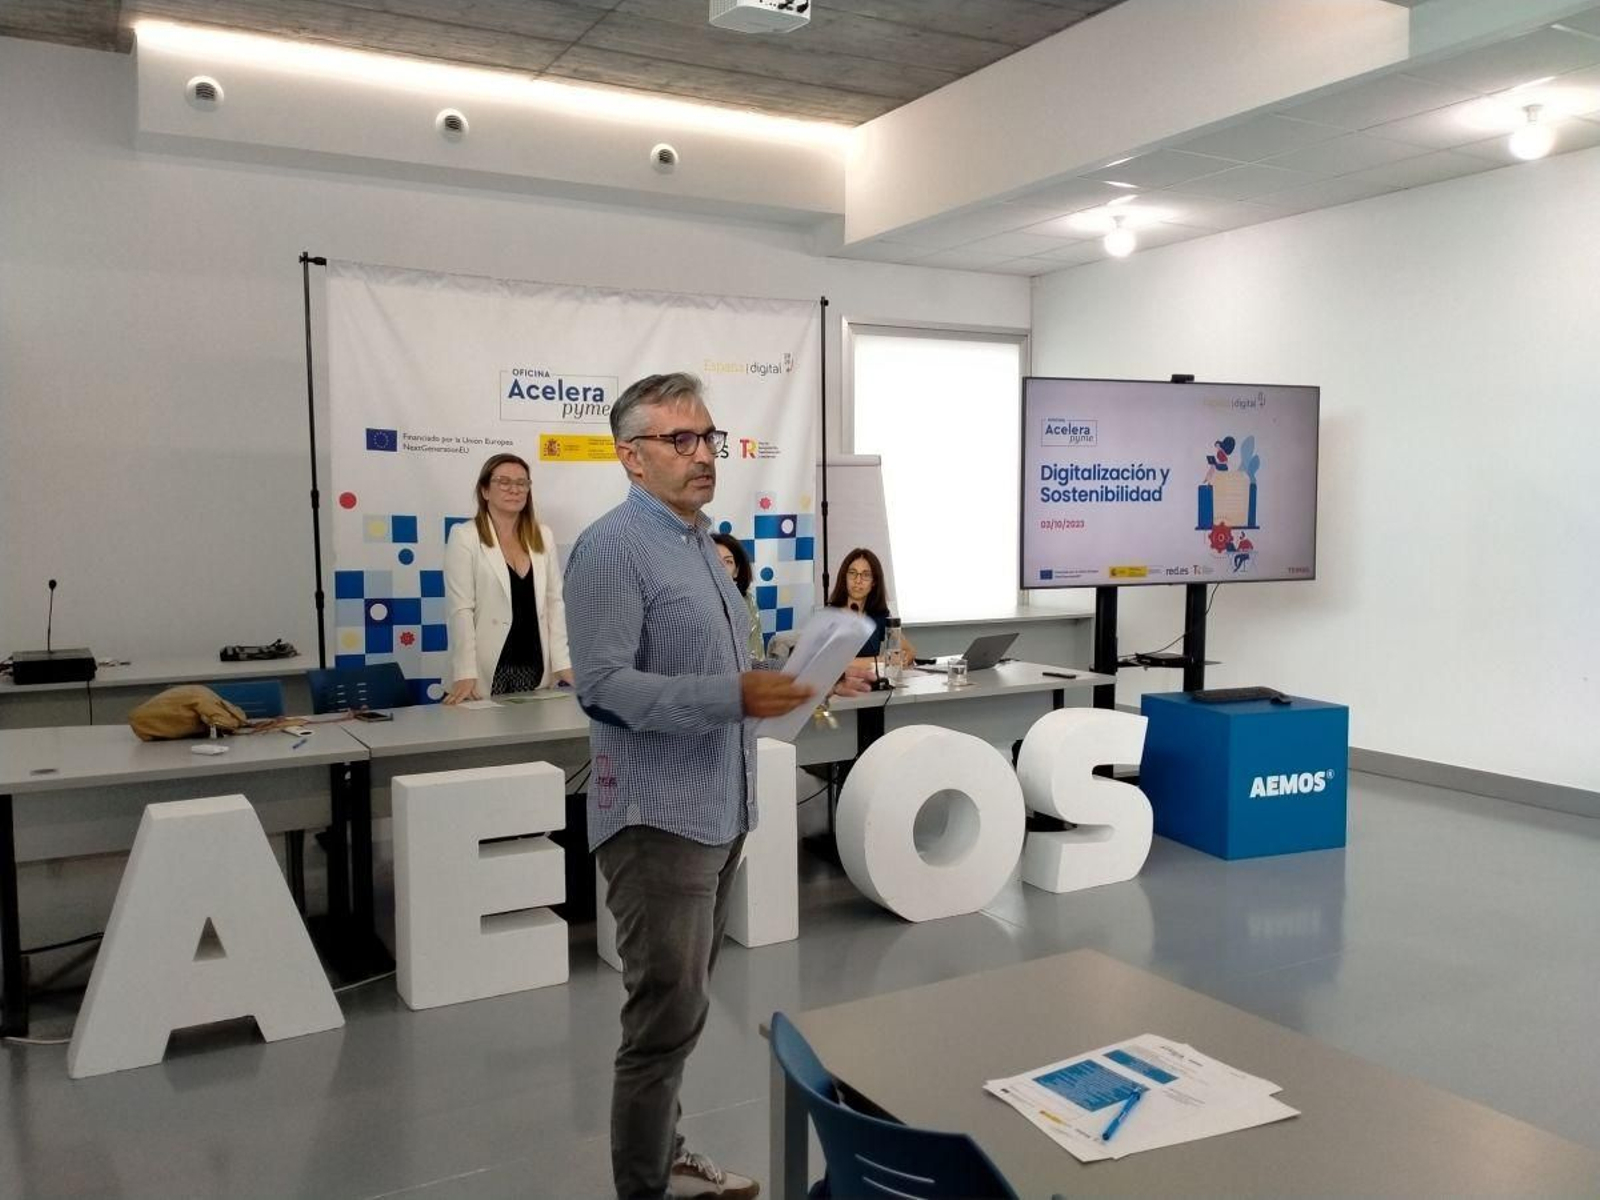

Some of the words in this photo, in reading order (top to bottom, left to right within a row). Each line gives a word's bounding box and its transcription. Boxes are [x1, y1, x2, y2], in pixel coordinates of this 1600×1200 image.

[512, 368, 551, 378] OFICINA
[749, 362, 782, 376] digital
[508, 379, 605, 402] Acelera
[562, 402, 611, 419] pyme
[1045, 422, 1091, 435] Acelera
[403, 432, 441, 442] Financiado
[441, 437, 453, 445] por
[455, 436, 462, 444] la
[1040, 463, 1157, 486] Digitalización
[1160, 468, 1170, 486] y
[1040, 485, 1163, 503] Sostenibilidad
